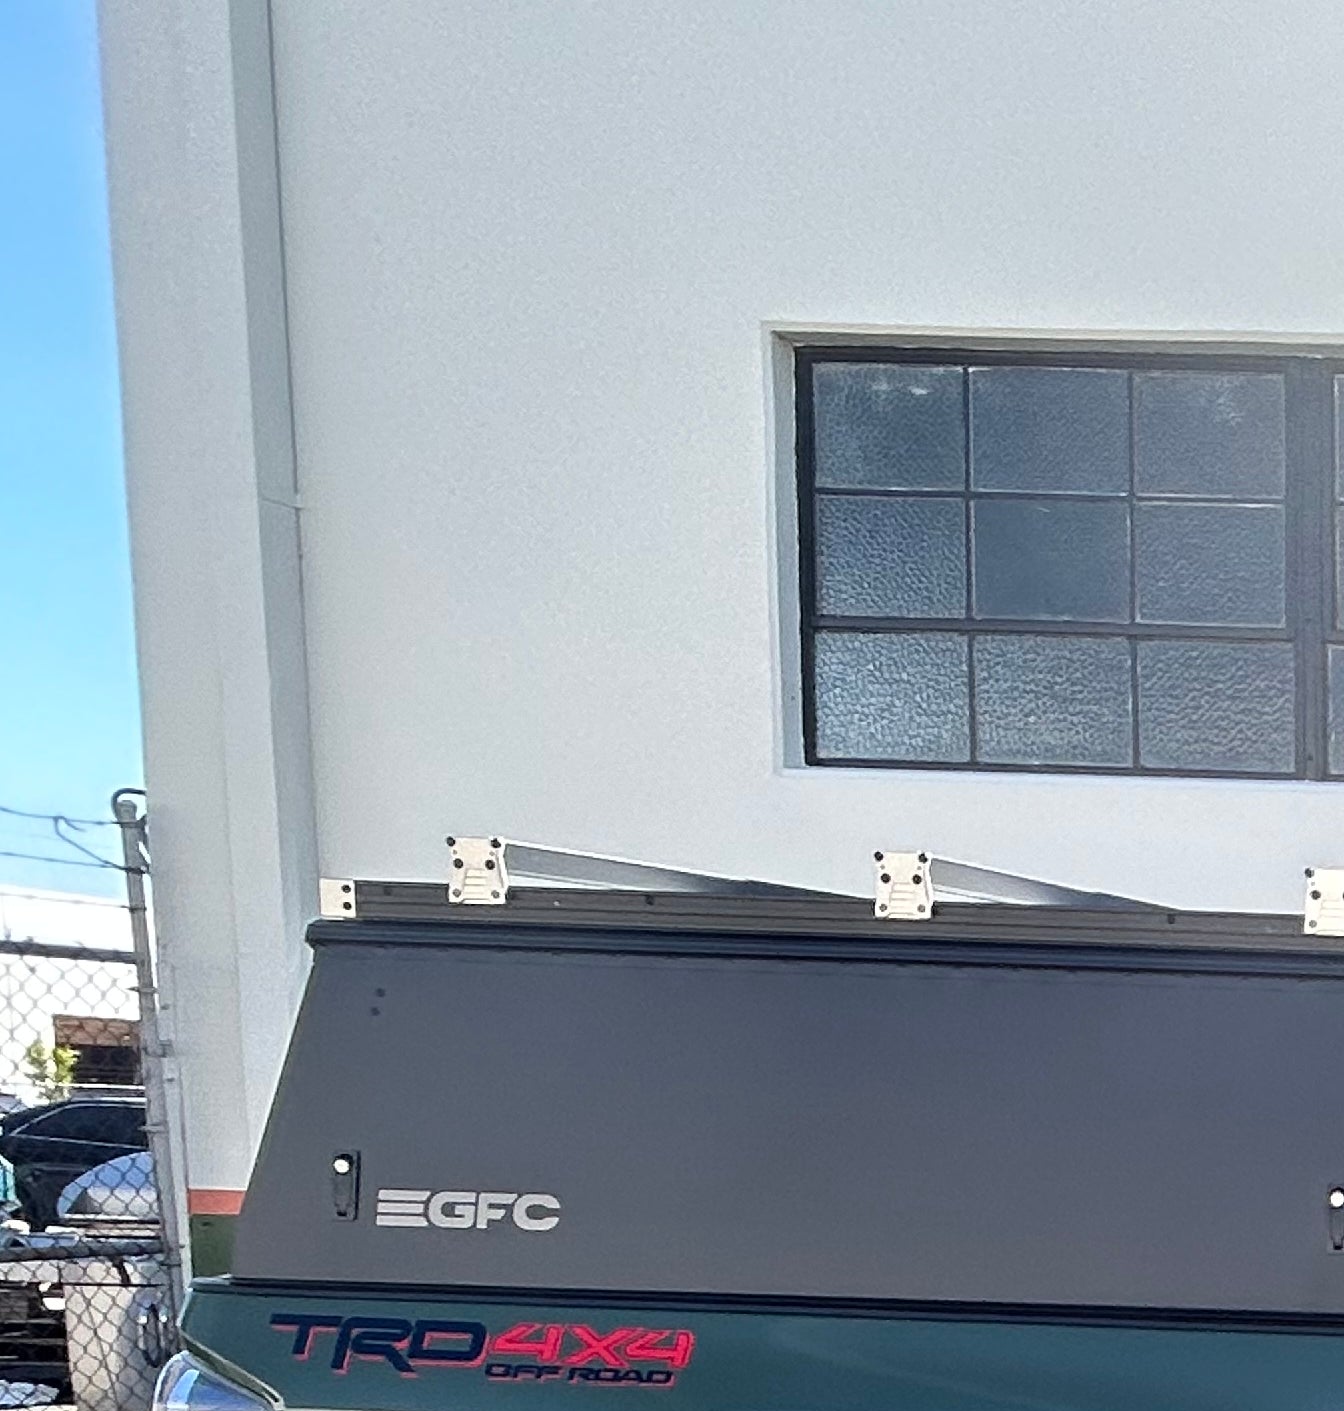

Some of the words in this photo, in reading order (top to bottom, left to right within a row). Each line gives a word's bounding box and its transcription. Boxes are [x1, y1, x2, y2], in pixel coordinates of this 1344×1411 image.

[269, 1313, 488, 1379] TRD
[484, 1363, 564, 1383] OFF
[567, 1367, 676, 1389] ROAD
